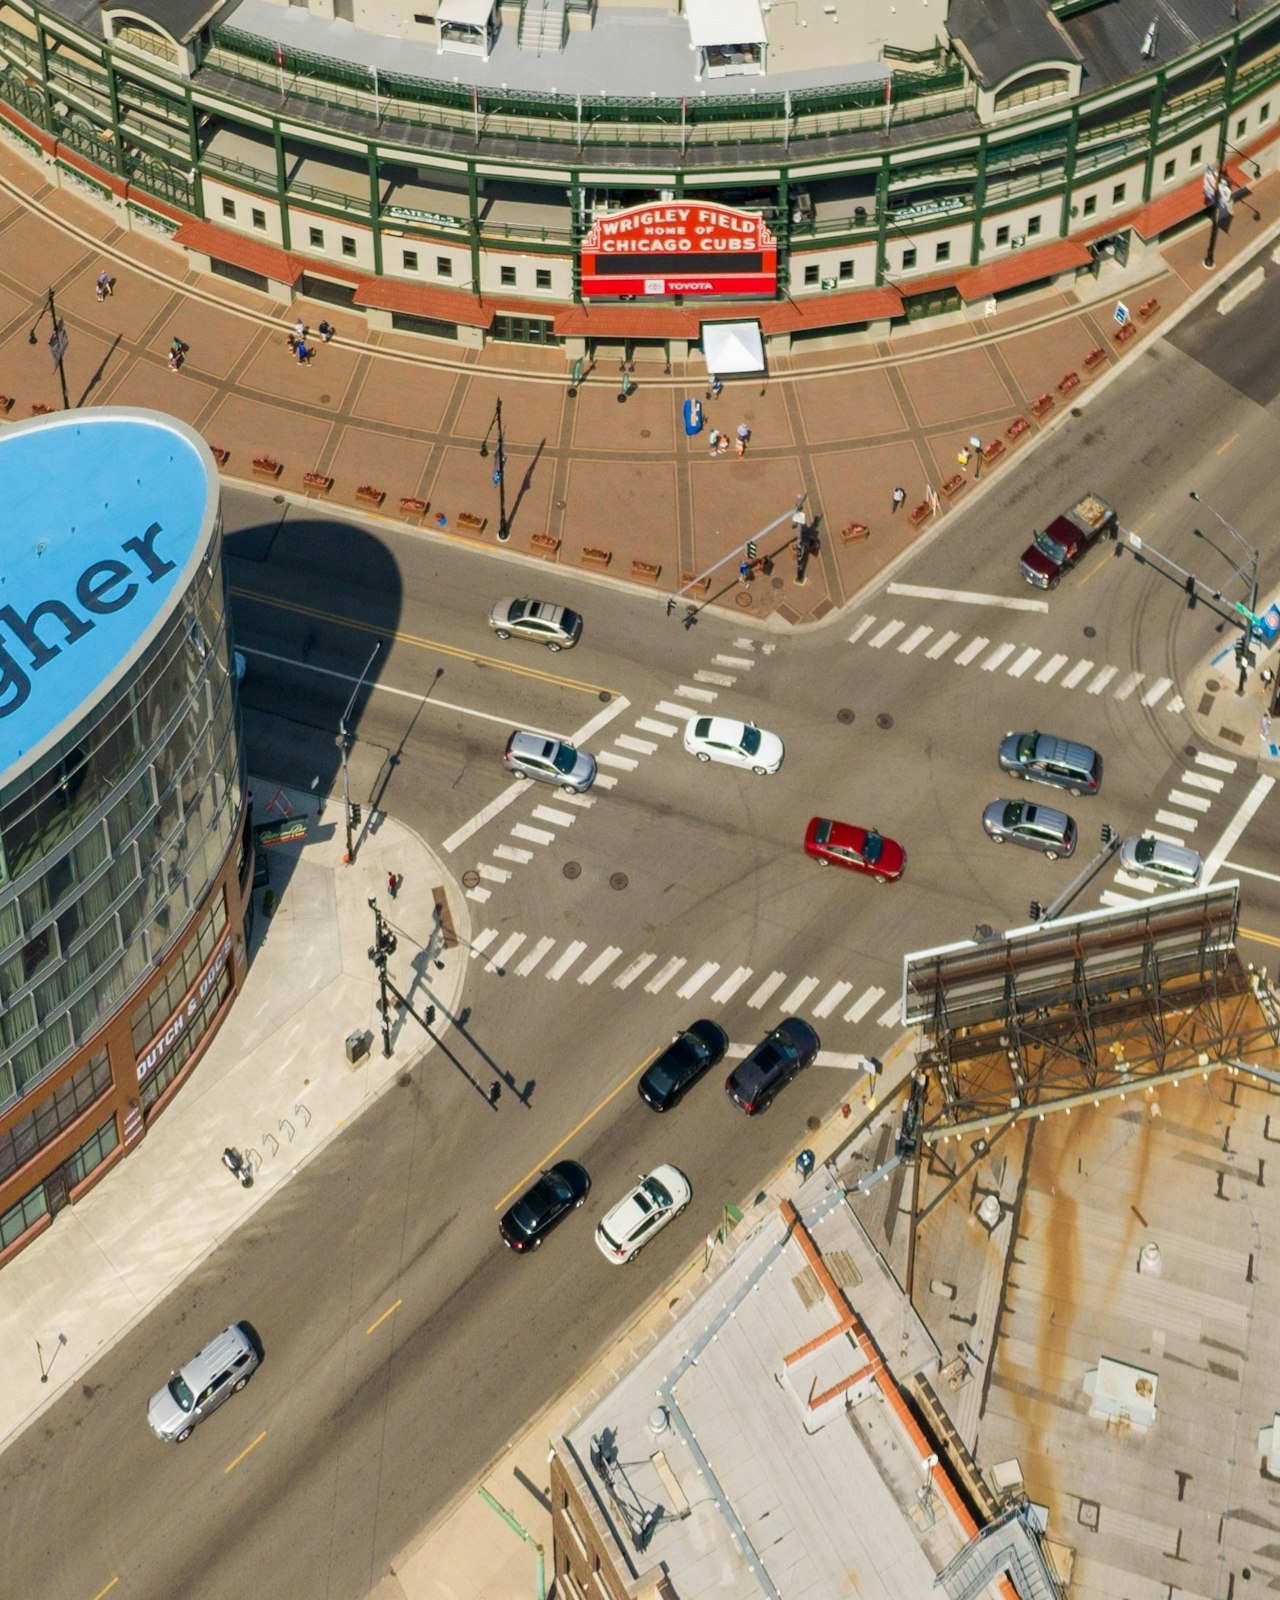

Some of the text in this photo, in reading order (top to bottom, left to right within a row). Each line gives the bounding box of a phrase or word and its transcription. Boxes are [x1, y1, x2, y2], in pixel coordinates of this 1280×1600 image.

[390, 206, 432, 218] GATES
[903, 203, 939, 215] GATES
[602, 209, 755, 235] WRIGLEY FIELD
[645, 226, 715, 235] HOME OF
[603, 238, 756, 252] CHICAGO CUBS
[668, 282, 713, 291] TOYOTA
[137, 936, 232, 1081] DUTCH & DOC'S
